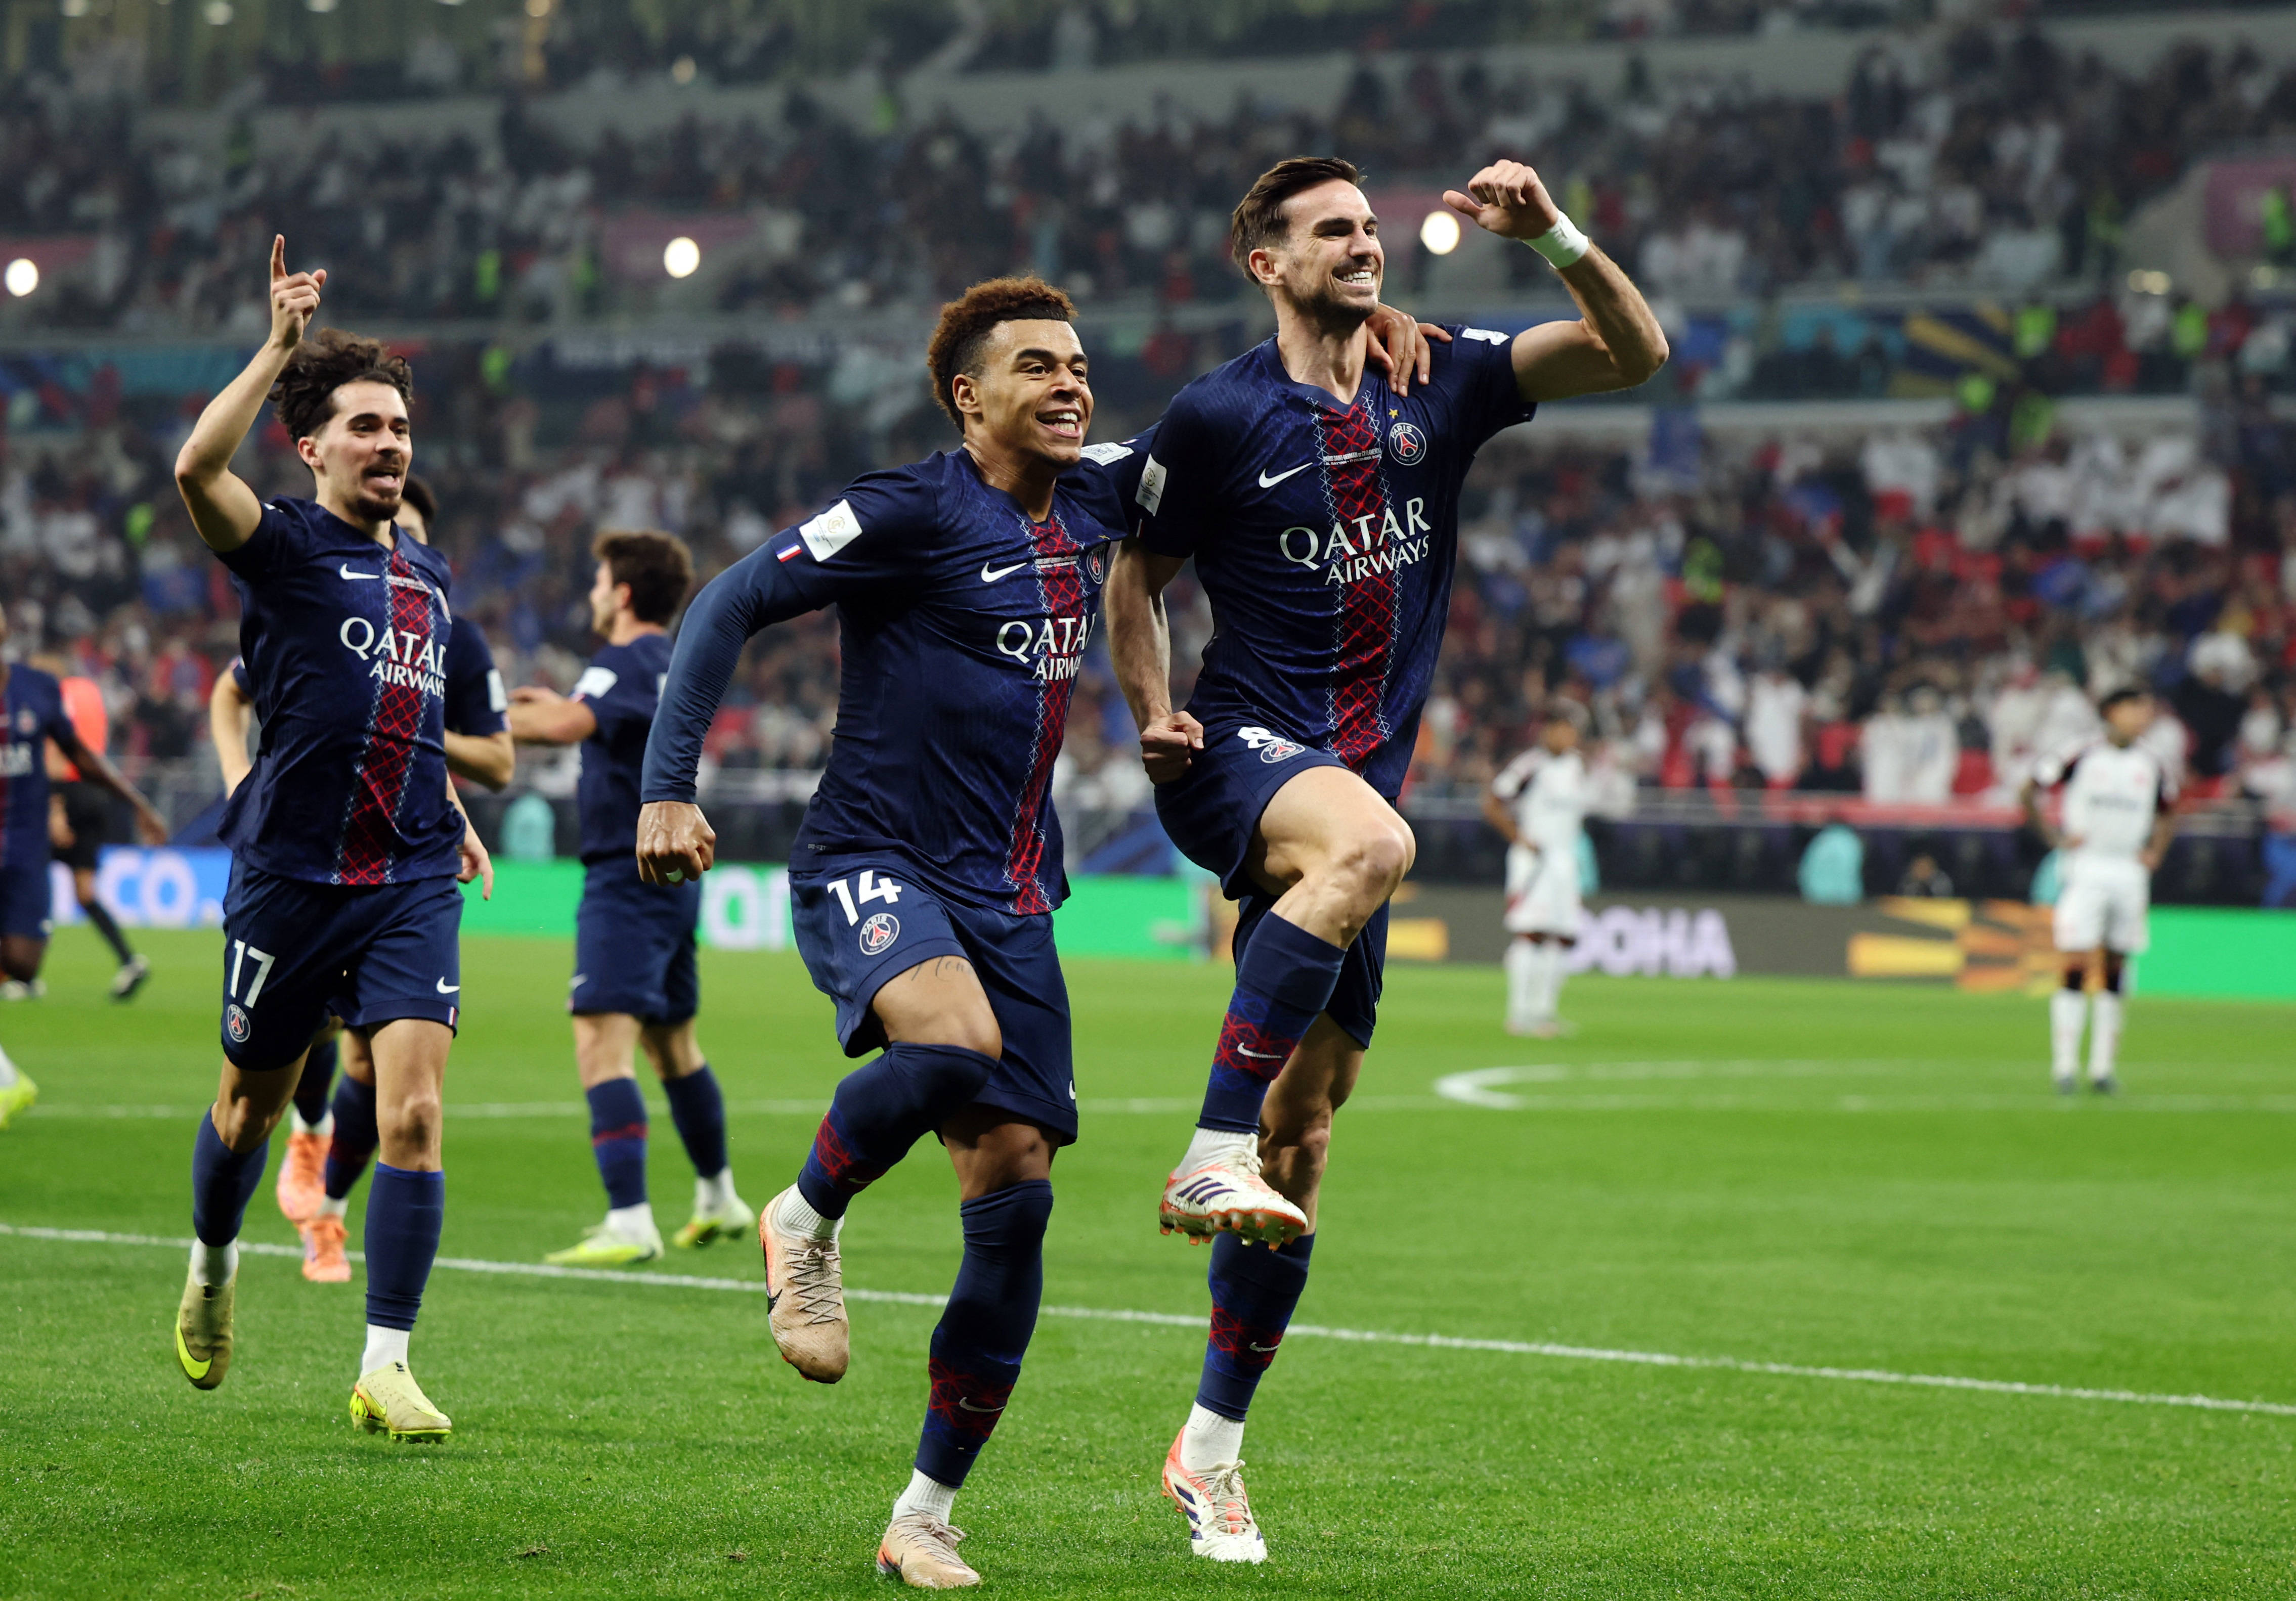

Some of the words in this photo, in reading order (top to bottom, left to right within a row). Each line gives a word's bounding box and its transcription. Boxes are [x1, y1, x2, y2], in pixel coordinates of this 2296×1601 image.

[1391, 425, 1412, 439] PARIS
[1280, 497, 1431, 571] QATAR
[1325, 535, 1429, 586] AIRWAYS
[1237, 727, 1287, 749] 8
[827, 869, 902, 927] 14
[230, 939, 276, 1009] 17
